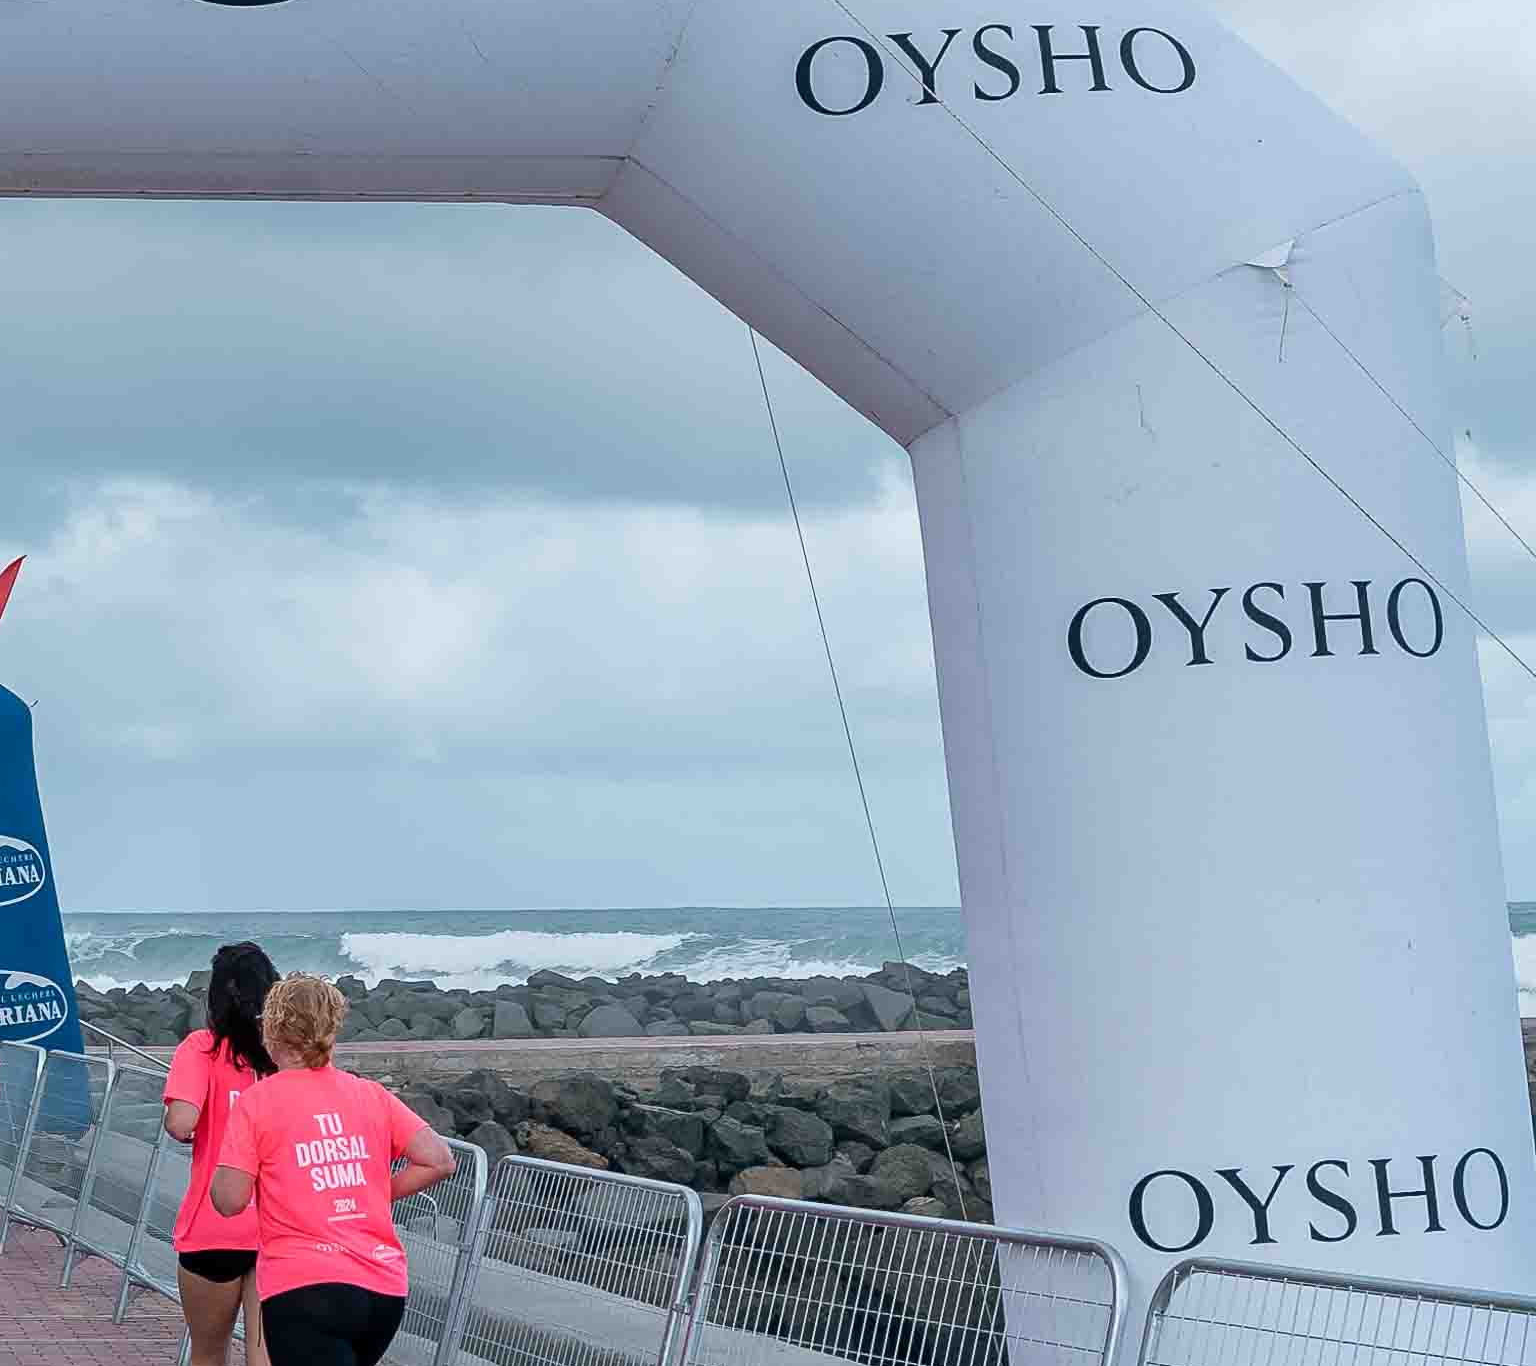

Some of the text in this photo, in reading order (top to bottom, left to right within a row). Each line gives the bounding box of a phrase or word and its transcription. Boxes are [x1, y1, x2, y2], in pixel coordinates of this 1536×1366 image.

[794, 23, 1197, 116] OYSHO
[1067, 578, 1444, 679] OYSHO
[295, 1136, 371, 1168] DORSAL
[313, 1112, 343, 1137] TU
[310, 1164, 367, 1192] SUMA
[1127, 1147, 1510, 1254] OYSHO
